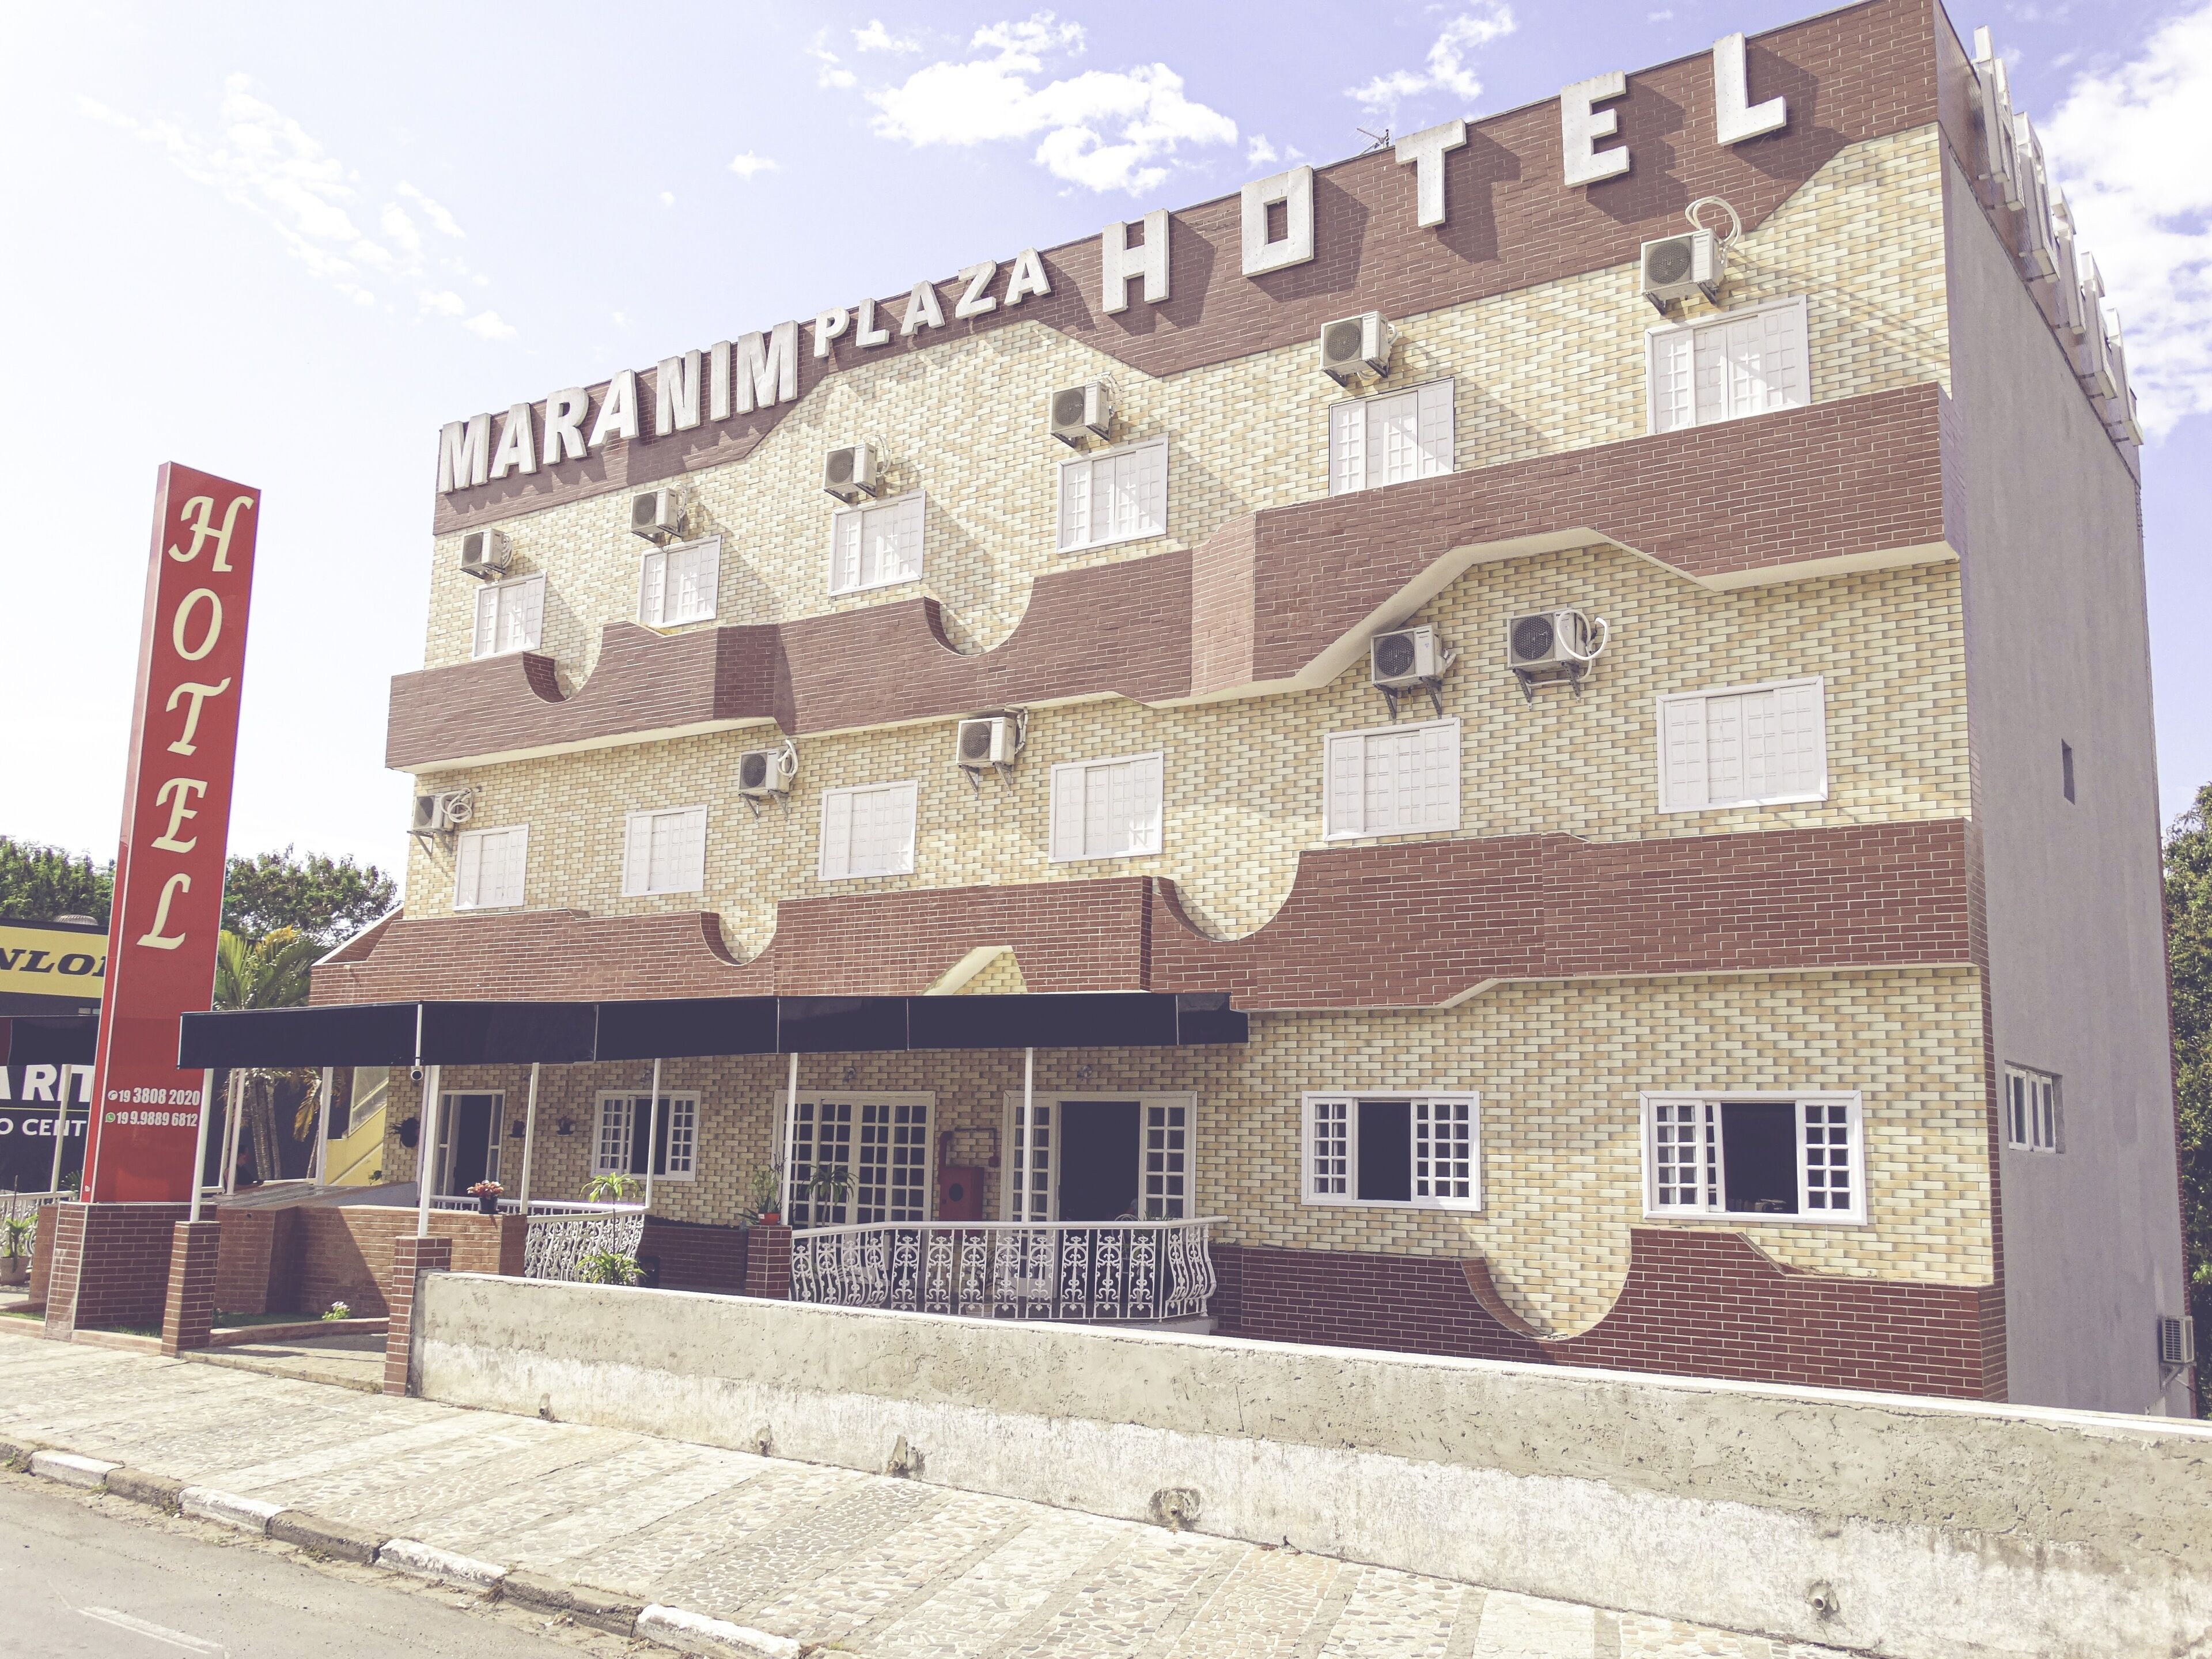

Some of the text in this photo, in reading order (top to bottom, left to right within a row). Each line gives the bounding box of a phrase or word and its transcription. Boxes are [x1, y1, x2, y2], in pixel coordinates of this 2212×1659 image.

[437, 32, 1787, 494] MARANIM PLAZA HOTEL
[136, 495, 254, 950] HOTEL
[116, 1111, 198, 1127] 19 9.9889 6812
[118, 1087, 200, 1105] 19 3808 2020
